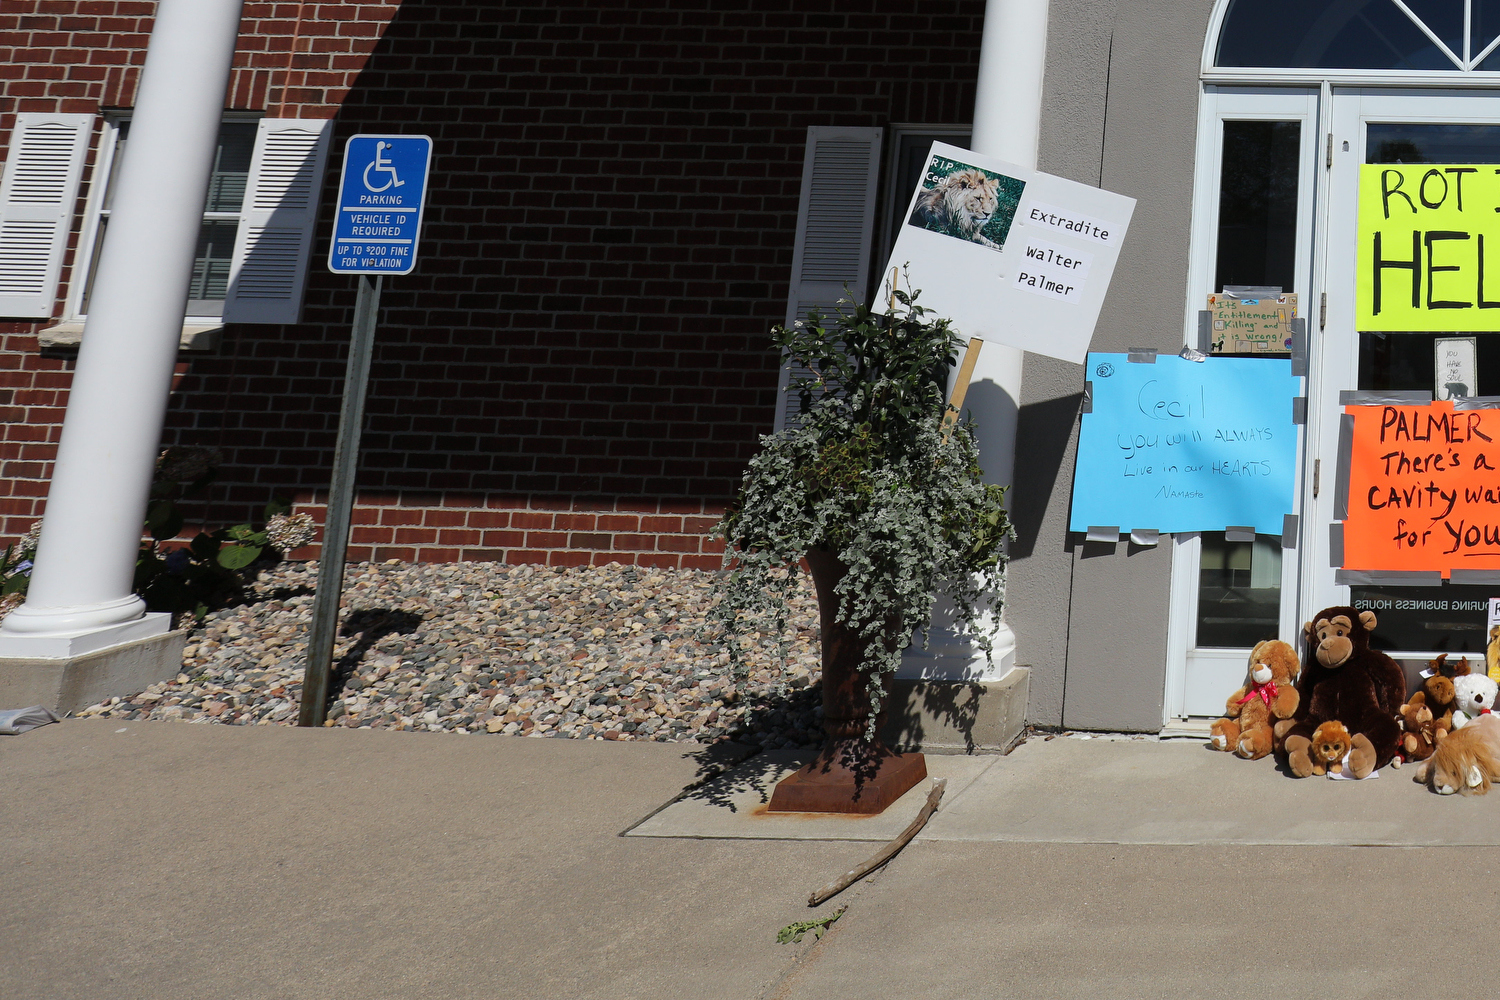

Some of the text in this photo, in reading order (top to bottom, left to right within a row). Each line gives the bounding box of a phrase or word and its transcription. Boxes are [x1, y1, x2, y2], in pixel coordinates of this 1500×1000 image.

[930, 158, 954, 170] RIP
[926, 172, 950, 186] Cecil
[360, 195, 402, 204] PARKING
[1381, 168, 1478, 220] ROT
[351, 214, 406, 224] VEHICLE ID
[1029, 208, 1110, 241] Extradite
[352, 226, 400, 236] REQUIRED
[338, 246, 409, 256] UP TO $200 FINE
[1026, 246, 1082, 270] Walter
[342, 258, 358, 267] FOR
[1018, 272, 1074, 296] Palmer
[1138, 380, 1206, 420] Cecil
[1380, 406, 1492, 444] PALMER
[1166, 430, 1202, 446] will
[1214, 427, 1273, 443] ALWAYS
[1124, 460, 1272, 477] Live in our HEARTS
[1380, 448, 1461, 476] There's
[1474, 453, 1496, 471] a
[1393, 518, 1431, 549] for
